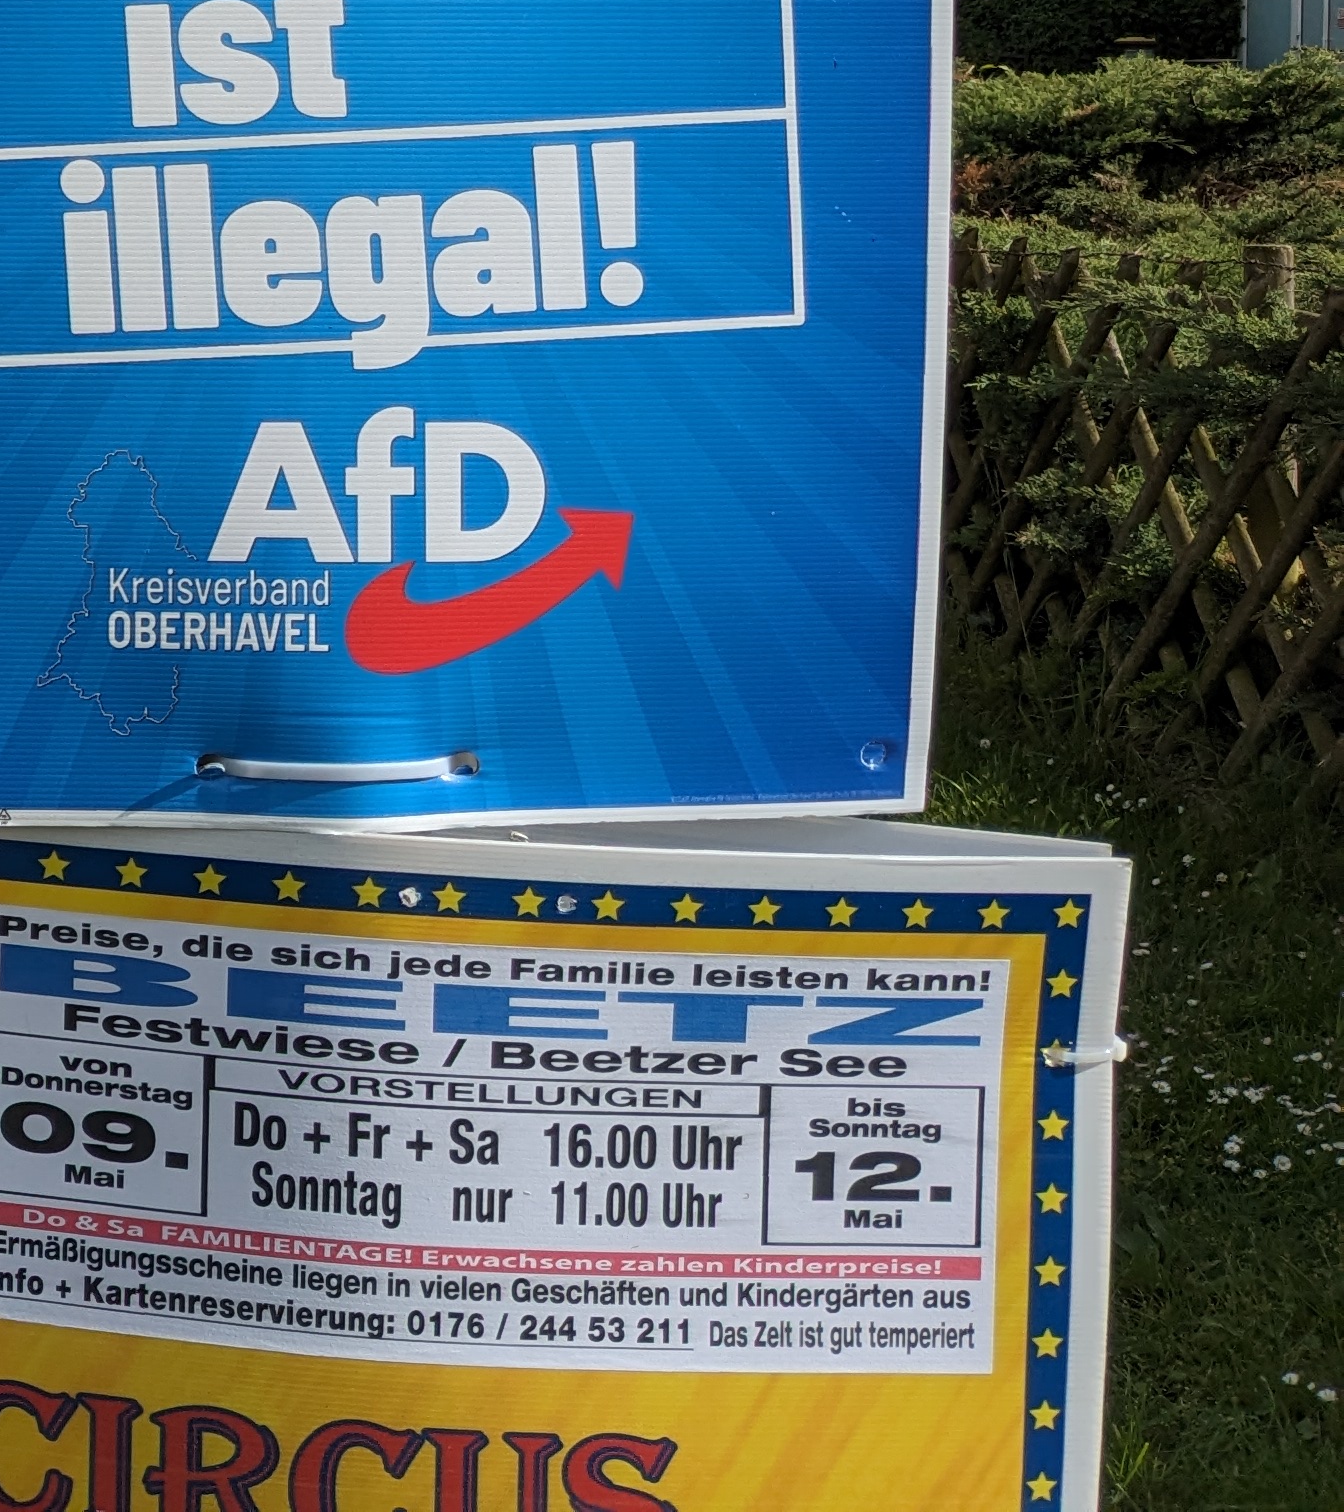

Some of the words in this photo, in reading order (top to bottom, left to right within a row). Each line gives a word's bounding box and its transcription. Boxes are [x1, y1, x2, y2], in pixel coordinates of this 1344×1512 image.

[60, 140, 643, 369] illegal!
[207, 406, 545, 563] AfD
[108, 568, 329, 606] Kreisverband
[108, 611, 329, 652] OBERHAVEL
[0, 915, 163, 958] Preise,
[182, 934, 253, 962] die
[271, 945, 371, 972] sich
[389, 950, 492, 979] jede
[511, 957, 674, 986] Familie
[693, 964, 848, 990] leisten
[866, 969, 991, 992] kann!
[0, 943, 984, 1046] BEETZ
[59, 1055, 133, 1077] von
[63, 1004, 420, 1065] Festwiese
[442, 1038, 468, 1068] /
[490, 1040, 757, 1076] Beetzer
[779, 1048, 907, 1078] See
[1, 1066, 193, 1110] Donnerstag
[278, 1069, 702, 1109] VORSTELLUNGEN
[847, 1097, 906, 1118] bis
[0, 1101, 189, 1170] 09.
[234, 1100, 287, 1151] Do
[303, 1121, 331, 1155] +
[348, 1112, 391, 1160] Fr
[406, 1129, 433, 1162] +
[450, 1119, 499, 1166] Sa
[543, 1122, 657, 1170] 16.00
[672, 1124, 742, 1171] Uhr
[809, 1118, 942, 1143] Sonntag
[64, 1163, 124, 1189] Mai
[252, 1161, 402, 1228] Sonntag
[453, 1185, 512, 1223] nur
[551, 1181, 648, 1228] 11.00
[663, 1182, 722, 1228] Uhr
[795, 1151, 952, 1202] 12.
[23, 1209, 66, 1229] Do
[75, 1215, 98, 1232] &
[108, 1220, 144, 1237] Sa
[162, 1226, 411, 1264] FAMILIENTAGE!
[422, 1249, 612, 1271] Erwachsene
[620, 1253, 724, 1273] zahlen
[734, 1256, 941, 1277] Kinderpreise!
[843, 1209, 902, 1229] Mai
[292, 1263, 377, 1299] liegen
[387, 1273, 410, 1299] in
[420, 1274, 502, 1302] vielen
[511, 1278, 670, 1307] Geschäften
[679, 1283, 727, 1307] und
[737, 1283, 913, 1313] Kindergärten
[923, 1289, 972, 1309] aus
[55, 1280, 72, 1299] +
[84, 1275, 395, 1339] Kartenreservierung:
[407, 1310, 485, 1339] 0176
[495, 1313, 509, 1341] /
[519, 1315, 576, 1342] 244
[587, 1317, 625, 1343] 53
[636, 1318, 690, 1345] 211
[710, 1321, 748, 1348] Das
[754, 1321, 793, 1348] Zelt
[799, 1321, 824, 1348] ist
[830, 1322, 863, 1355] gut
[869, 1321, 975, 1354] temperiert
